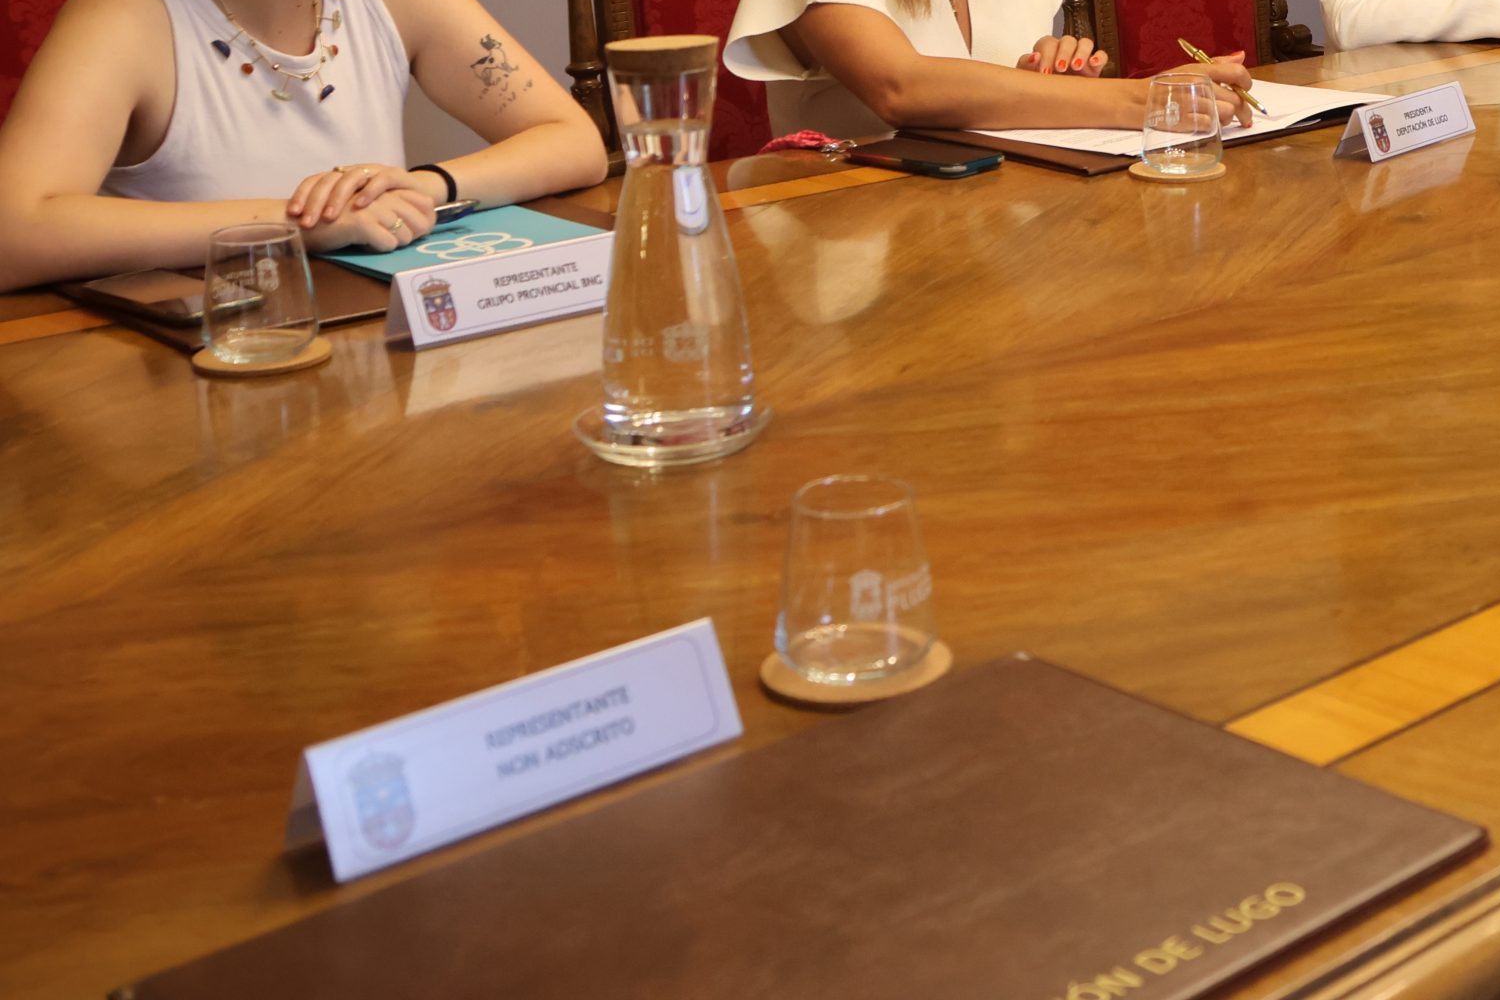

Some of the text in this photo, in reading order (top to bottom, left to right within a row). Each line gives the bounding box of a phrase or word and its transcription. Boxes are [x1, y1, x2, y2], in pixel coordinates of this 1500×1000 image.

[1396, 114, 1448, 136] DEPUTACIÓN DE LUGO
[1404, 106, 1432, 120] PRESIDENTA
[493, 262, 578, 287] REPRESENTANTE
[477, 292, 514, 310] GRUPO
[517, 280, 579, 302] PROVINCIAL
[1133, 881, 1306, 976] DE LUGO
